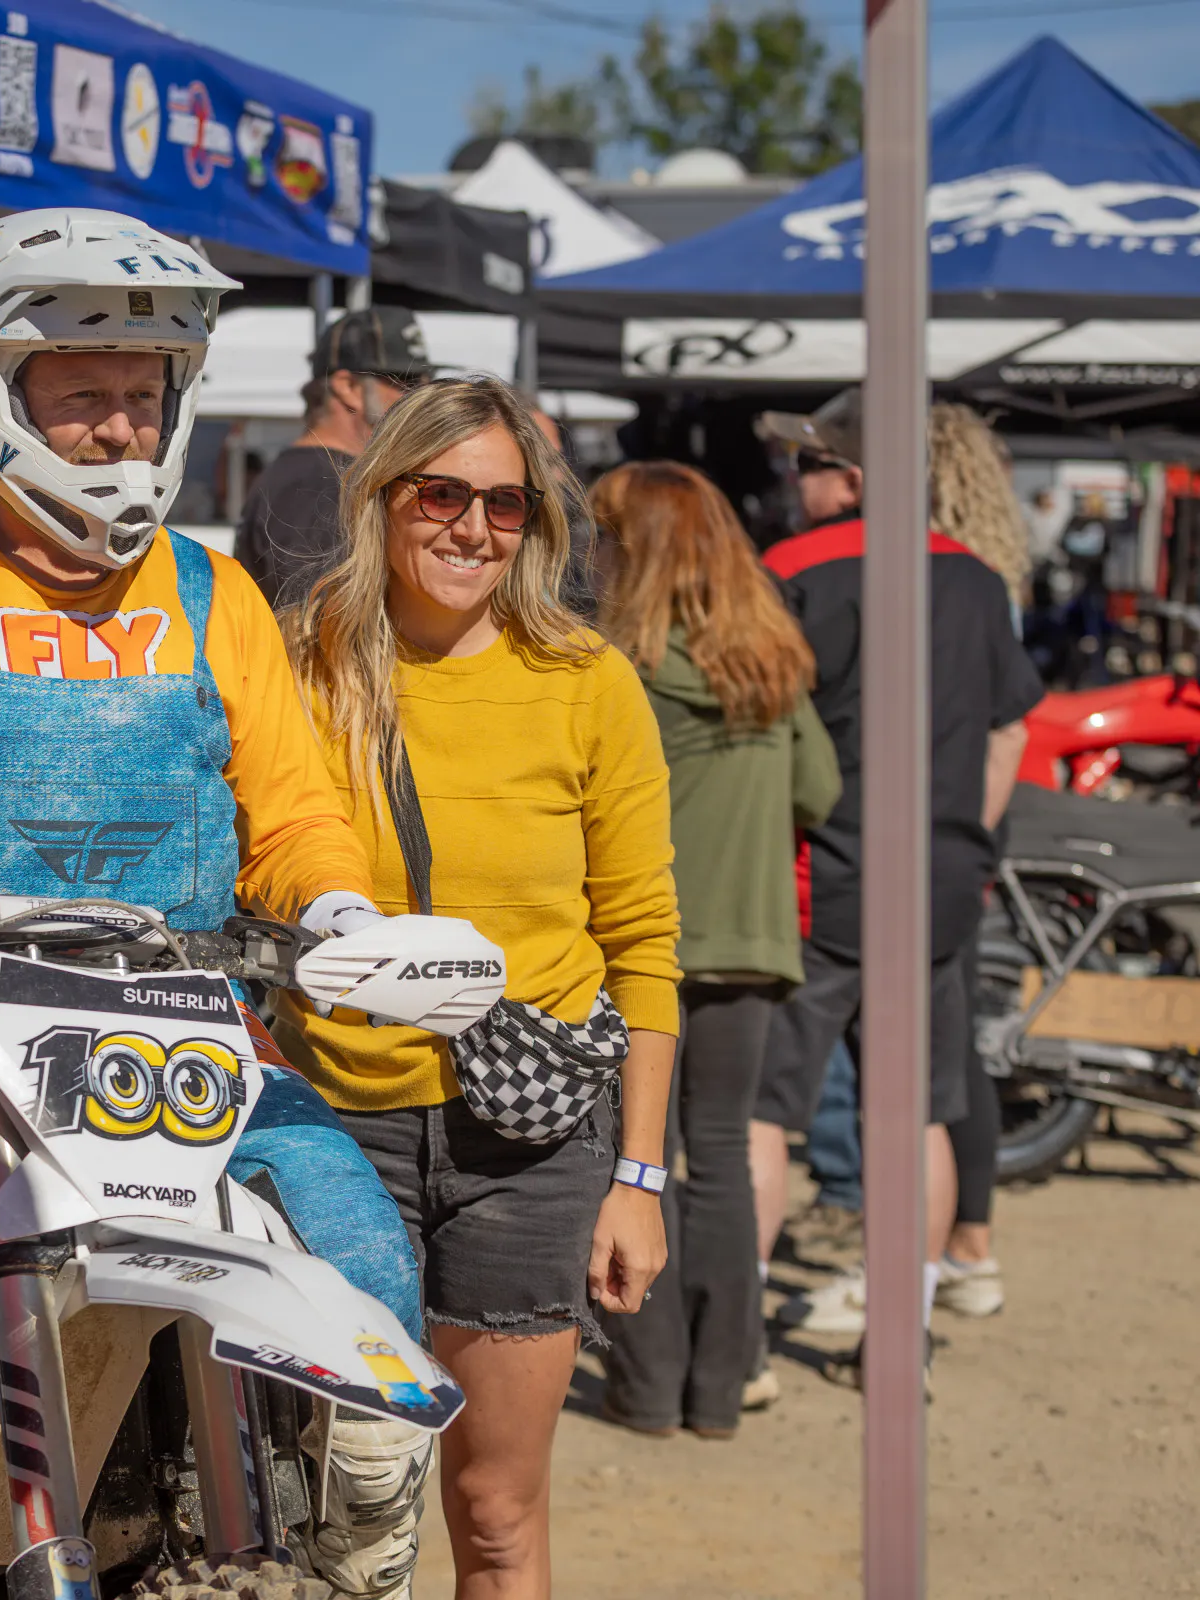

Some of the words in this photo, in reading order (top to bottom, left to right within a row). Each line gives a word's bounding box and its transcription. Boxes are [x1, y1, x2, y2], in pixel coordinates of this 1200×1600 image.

[113, 254, 205, 276] FLY
[124, 319, 160, 329] RHEON
[0, 612, 164, 680] FLY
[32, 913, 137, 927] andlebars
[396, 959, 502, 981] ACERBIS
[122, 987, 228, 1013] SUTHERLIN
[17, 1025, 247, 1147] 100
[103, 1182, 197, 1204] BACKYARD
[169, 1200, 193, 1209] DESIGN
